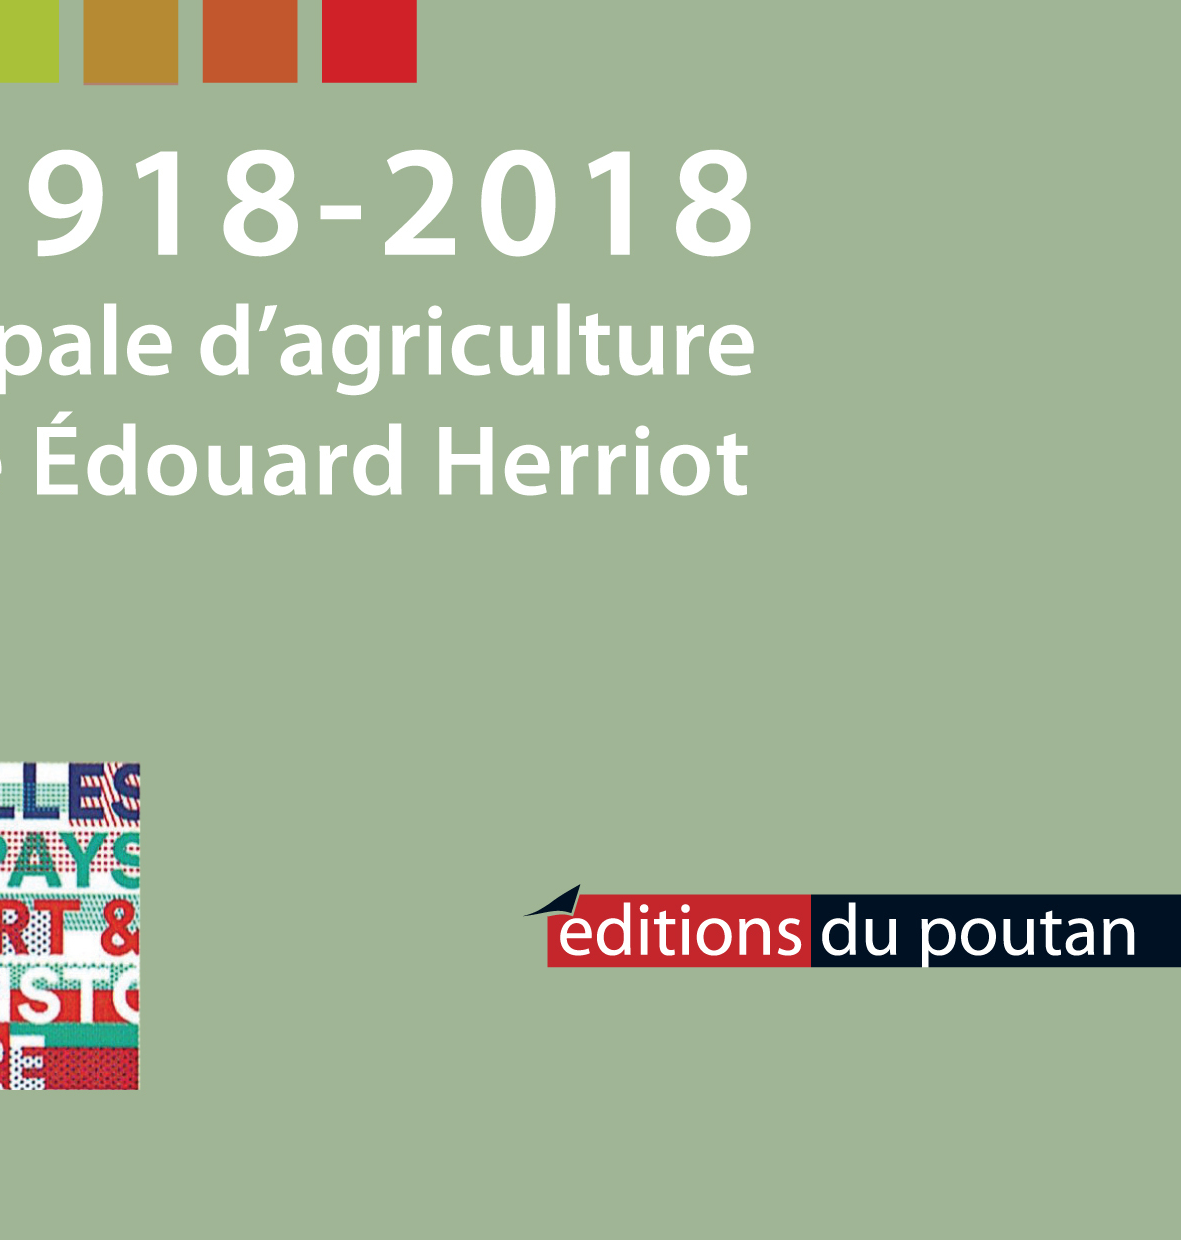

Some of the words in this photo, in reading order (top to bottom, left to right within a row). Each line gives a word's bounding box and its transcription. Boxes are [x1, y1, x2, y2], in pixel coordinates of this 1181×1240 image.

[200, 303, 755, 396] d’agriculture
[36, 411, 402, 496] Édouard
[438, 425, 748, 496] Herriot
[100, 898, 140, 957] &
[821, 902, 898, 957] du
[920, 910, 1136, 968] poutan
